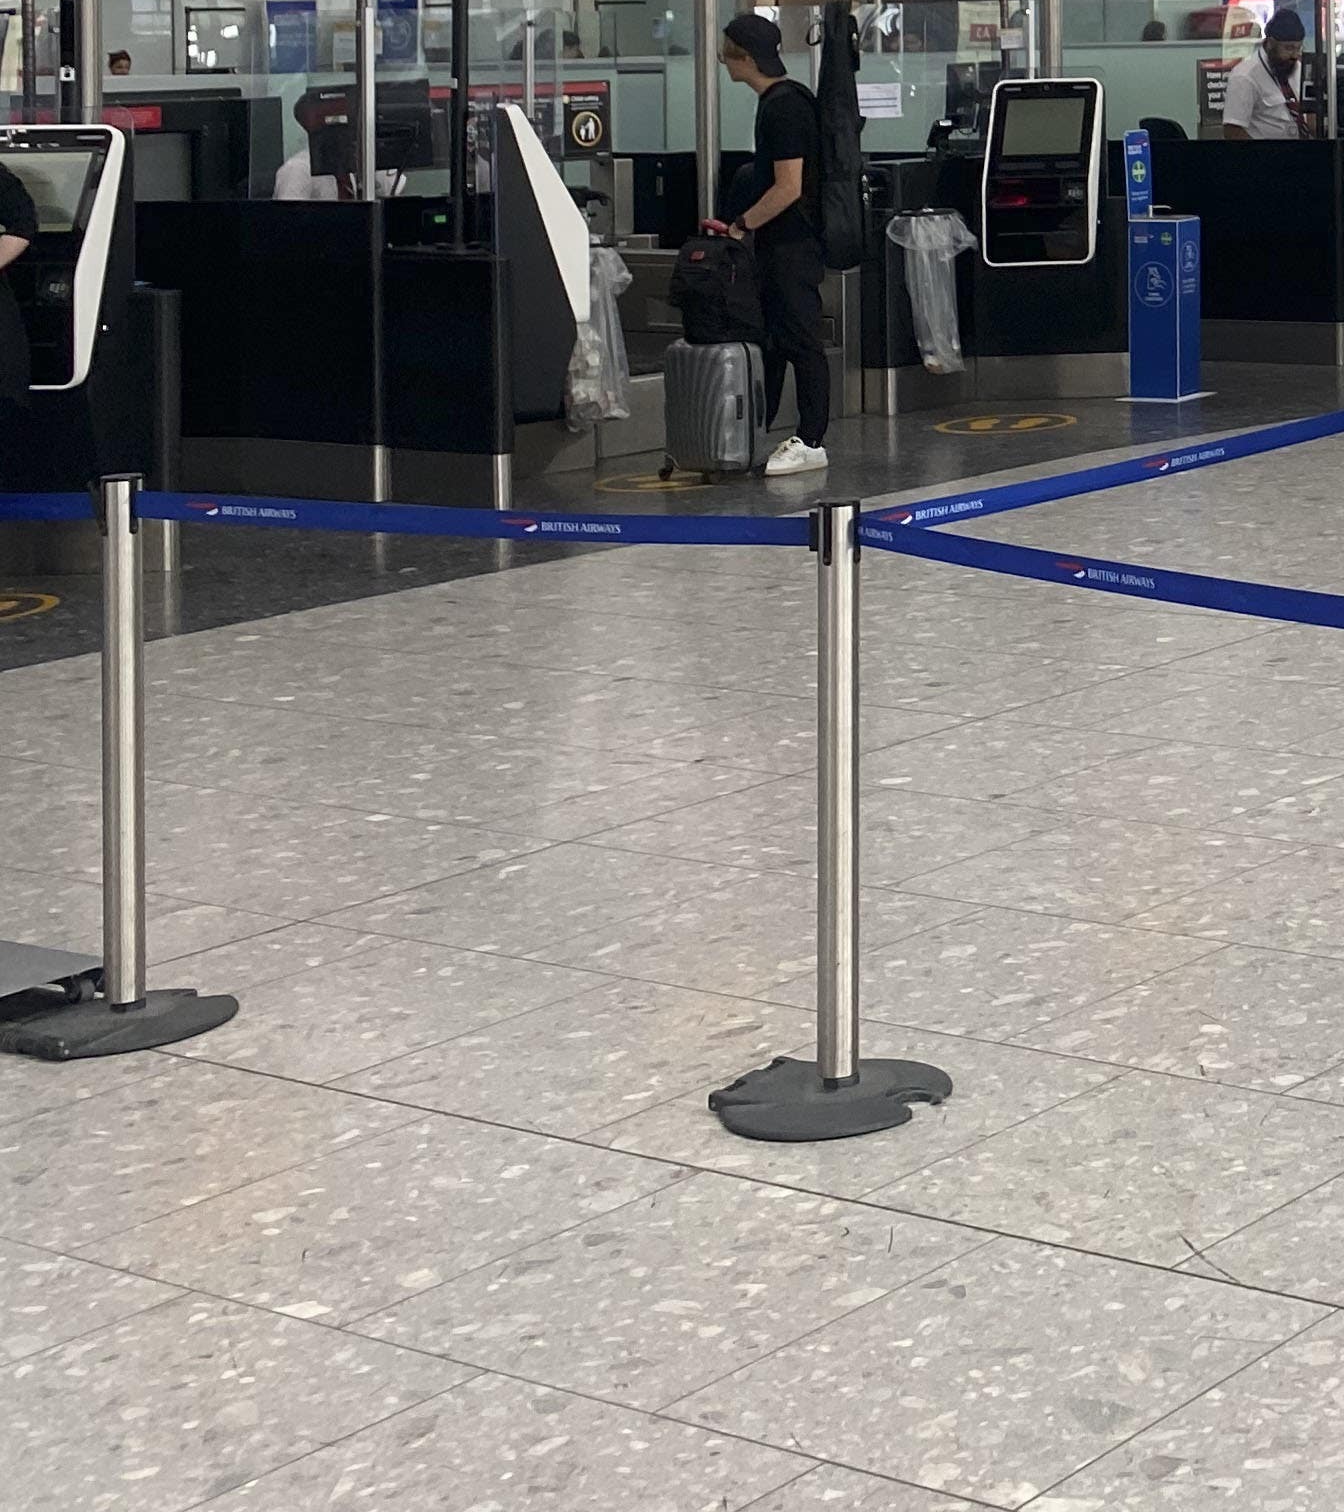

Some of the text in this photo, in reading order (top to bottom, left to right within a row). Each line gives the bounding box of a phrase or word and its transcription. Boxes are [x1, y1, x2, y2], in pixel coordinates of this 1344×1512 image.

[221, 505, 296, 520] BRITISH AIRWAYS
[915, 499, 983, 520] BRITISH AIRWAYS
[541, 521, 621, 534] BRITISH AIRWAYS
[1087, 567, 1155, 589] BRITISH AIRWAYS
